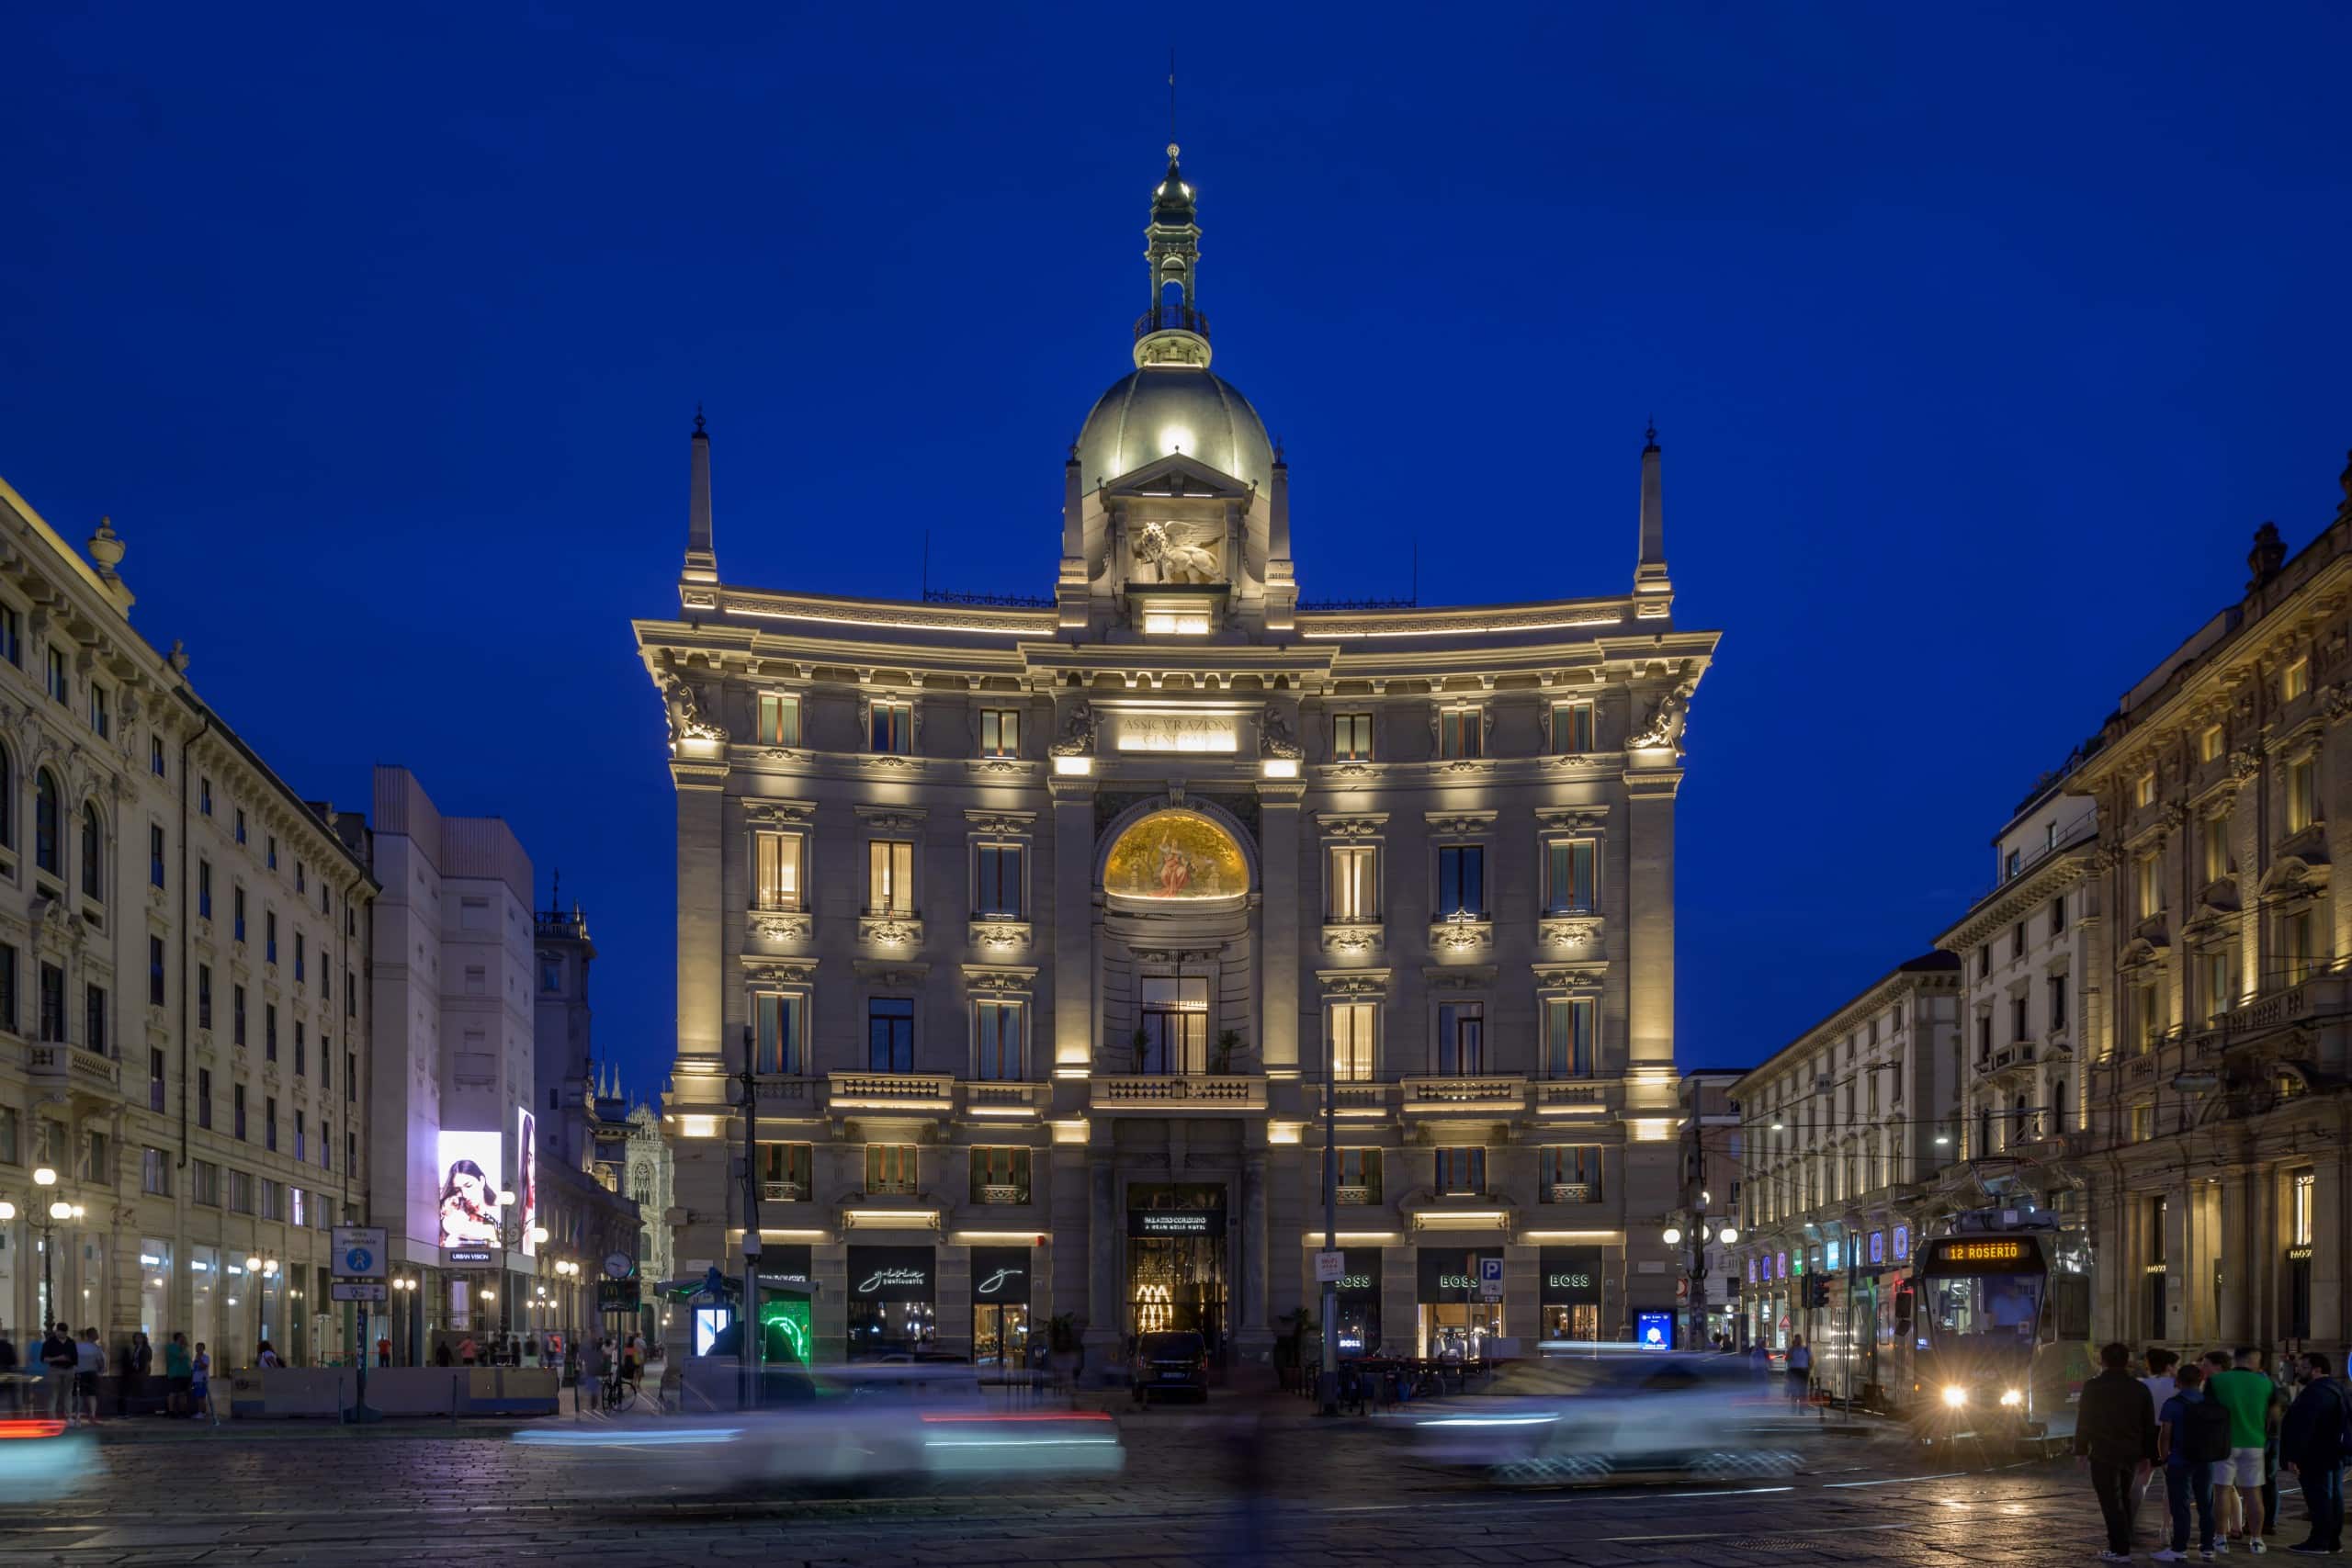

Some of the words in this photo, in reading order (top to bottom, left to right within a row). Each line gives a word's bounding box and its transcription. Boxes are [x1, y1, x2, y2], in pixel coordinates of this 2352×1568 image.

[1951, 1248, 1963, 1259] 12
[1969, 1247, 2018, 1258] ROSERIO
[1487, 1262, 1498, 1280] P
[1441, 1275, 1478, 1288] BOSS
[1550, 1274, 1589, 1288] BOSS
